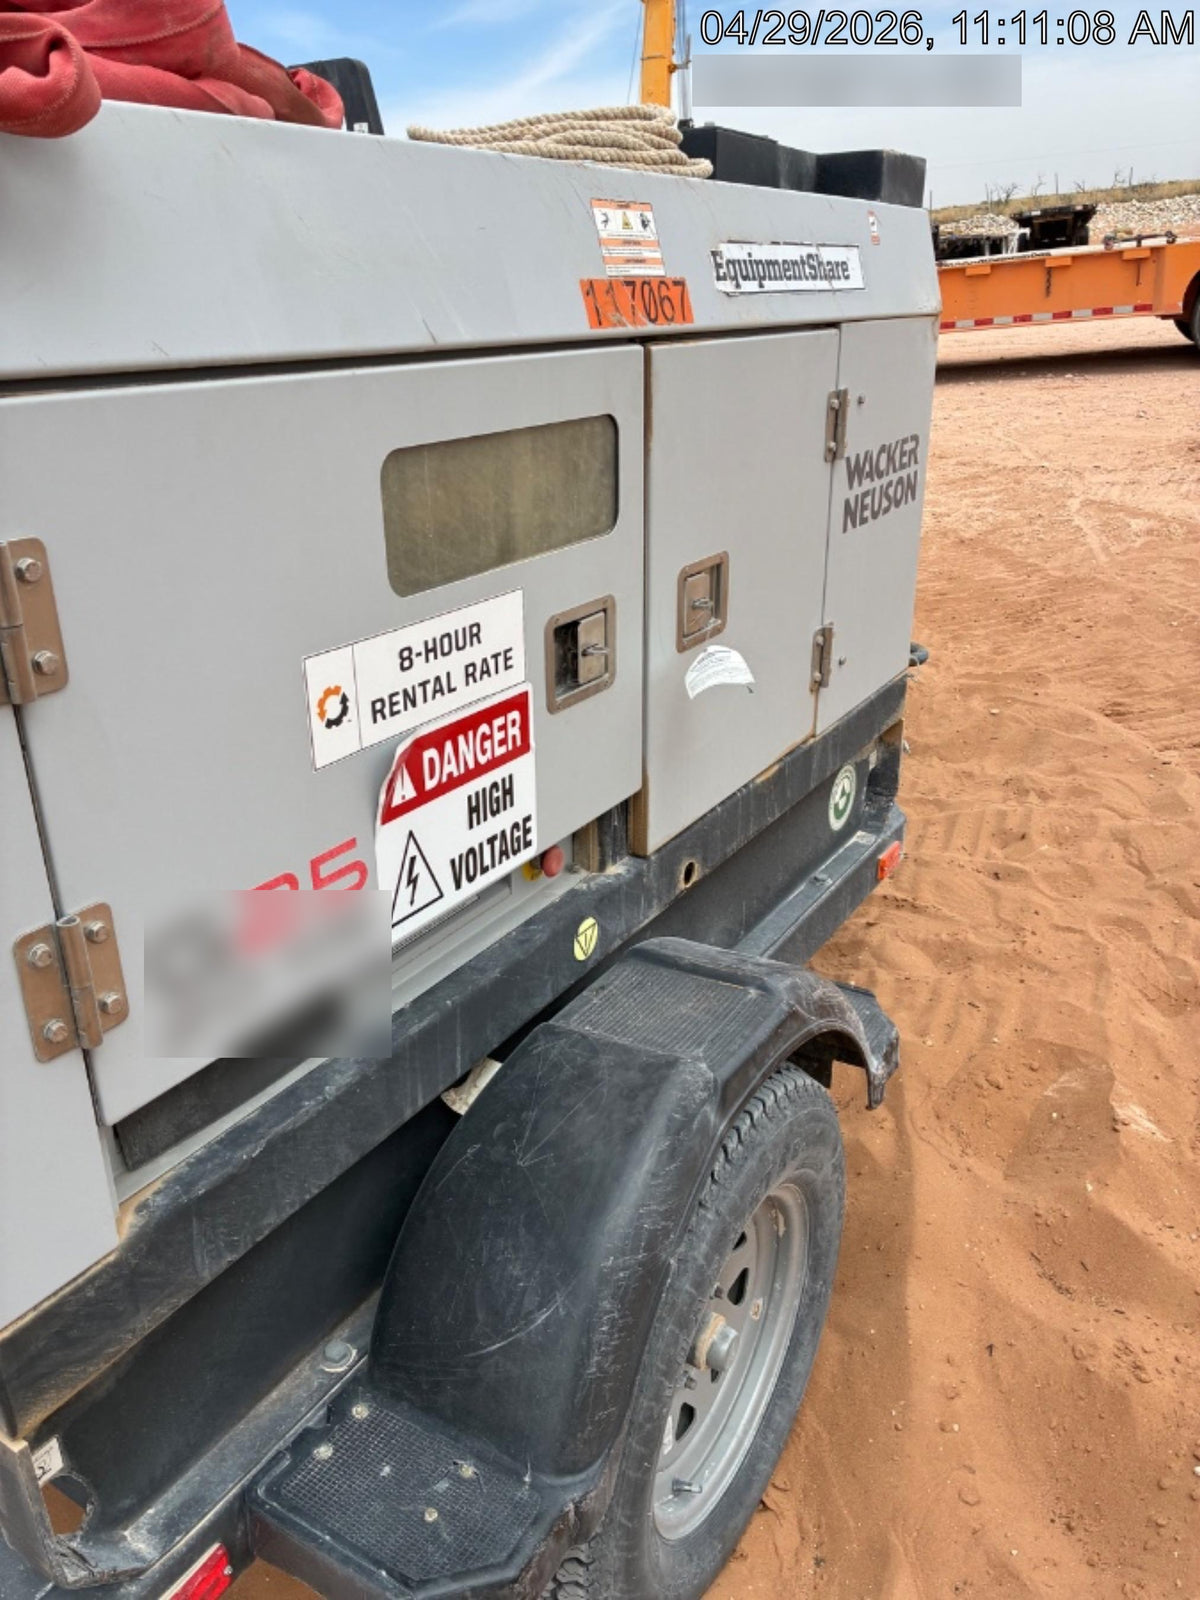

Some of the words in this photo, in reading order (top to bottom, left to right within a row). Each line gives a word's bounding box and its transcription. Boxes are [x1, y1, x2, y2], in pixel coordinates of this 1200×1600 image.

[711, 249, 850, 289] EquipmentShare
[586, 279, 687, 326] 117067
[846, 433, 920, 491] WACKER
[842, 469, 918, 534] NEUSON
[398, 621, 482, 672] 8-HOUR
[371, 671, 457, 724] RENTAL
[464, 647, 515, 687] RATE
[422, 709, 522, 792] DANGER
[466, 773, 515, 830] HIGH
[450, 814, 533, 891] VOLTAGE
